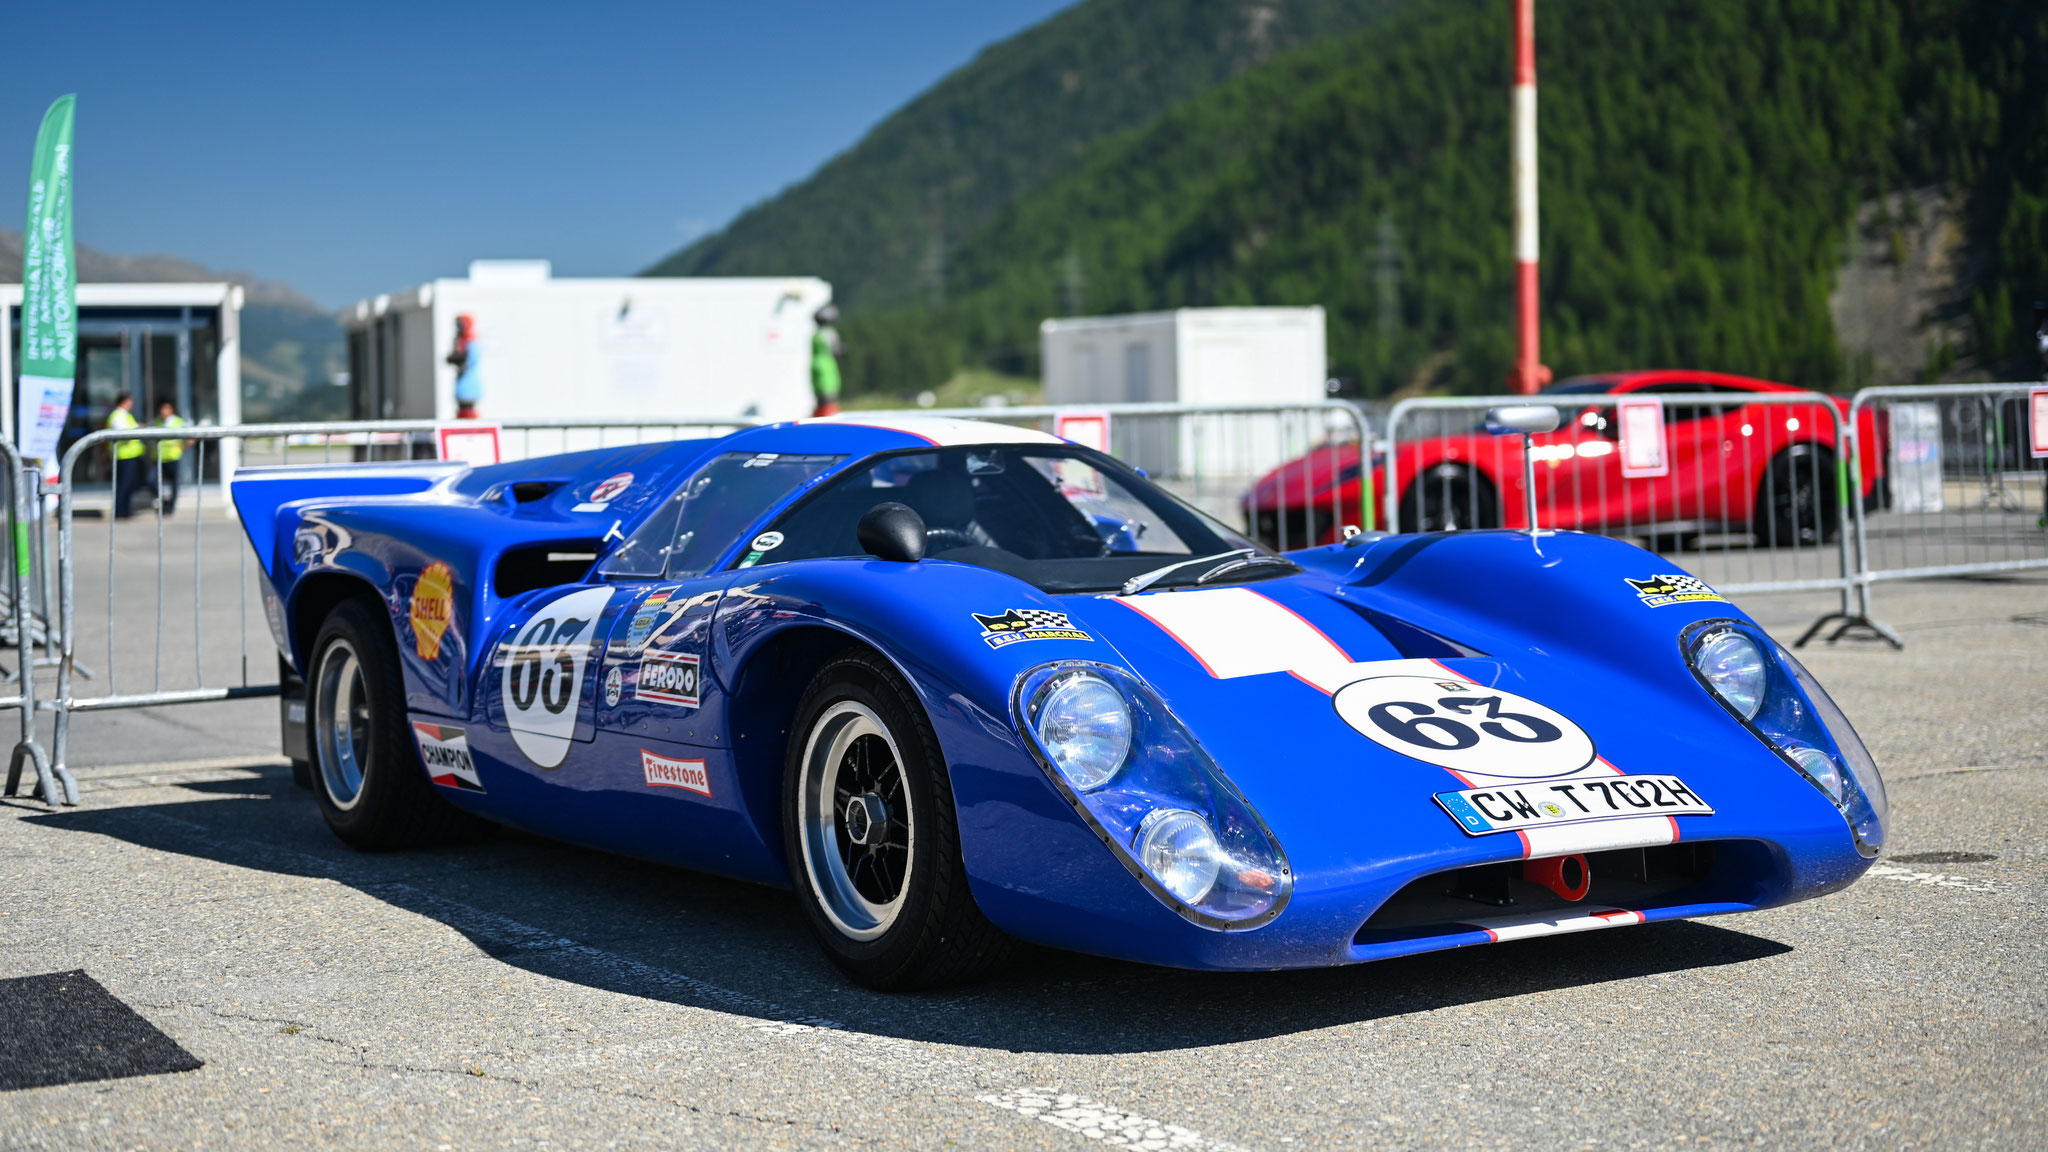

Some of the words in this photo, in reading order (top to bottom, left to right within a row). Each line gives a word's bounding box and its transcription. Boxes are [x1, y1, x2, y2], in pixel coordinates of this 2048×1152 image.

[415, 597, 446, 621] SHELL
[1023, 630, 1089, 639] MARCHAL
[510, 617, 592, 714] 63
[641, 663, 695, 693] FERODO
[1368, 695, 1563, 751] 63
[422, 743, 473, 772] CHAMPION
[646, 757, 705, 786] Firestone
[1470, 789, 1541, 822] CW
[1550, 785, 1590, 813] T
[1466, 815, 1480, 826] D
